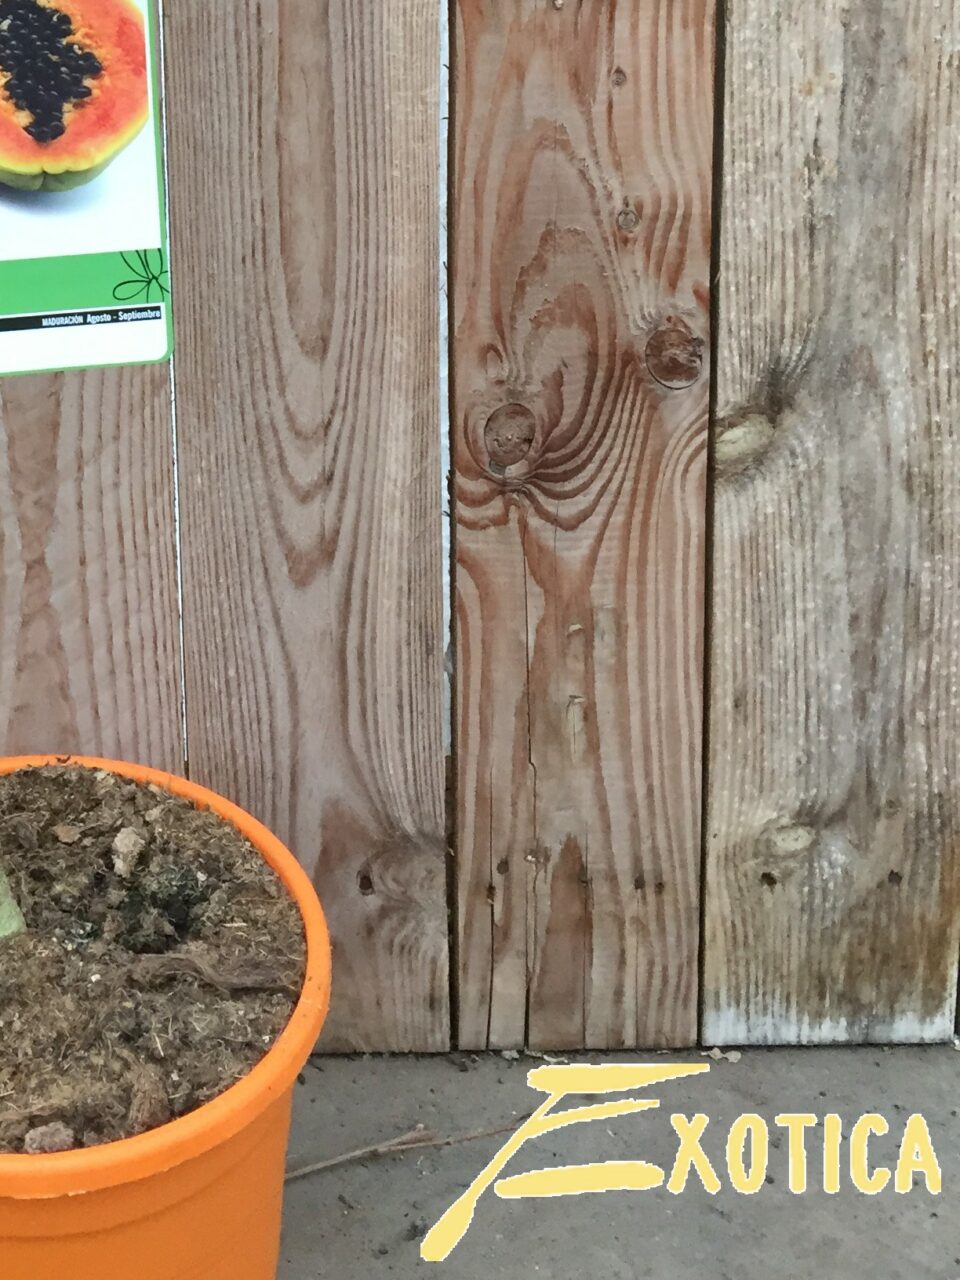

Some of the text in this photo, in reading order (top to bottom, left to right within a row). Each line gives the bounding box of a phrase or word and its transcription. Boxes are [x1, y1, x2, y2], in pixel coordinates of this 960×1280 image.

[42, 313, 84, 327] MADURACIÓN
[86, 313, 112, 325] Agosto
[118, 309, 161, 322] Septiembre
